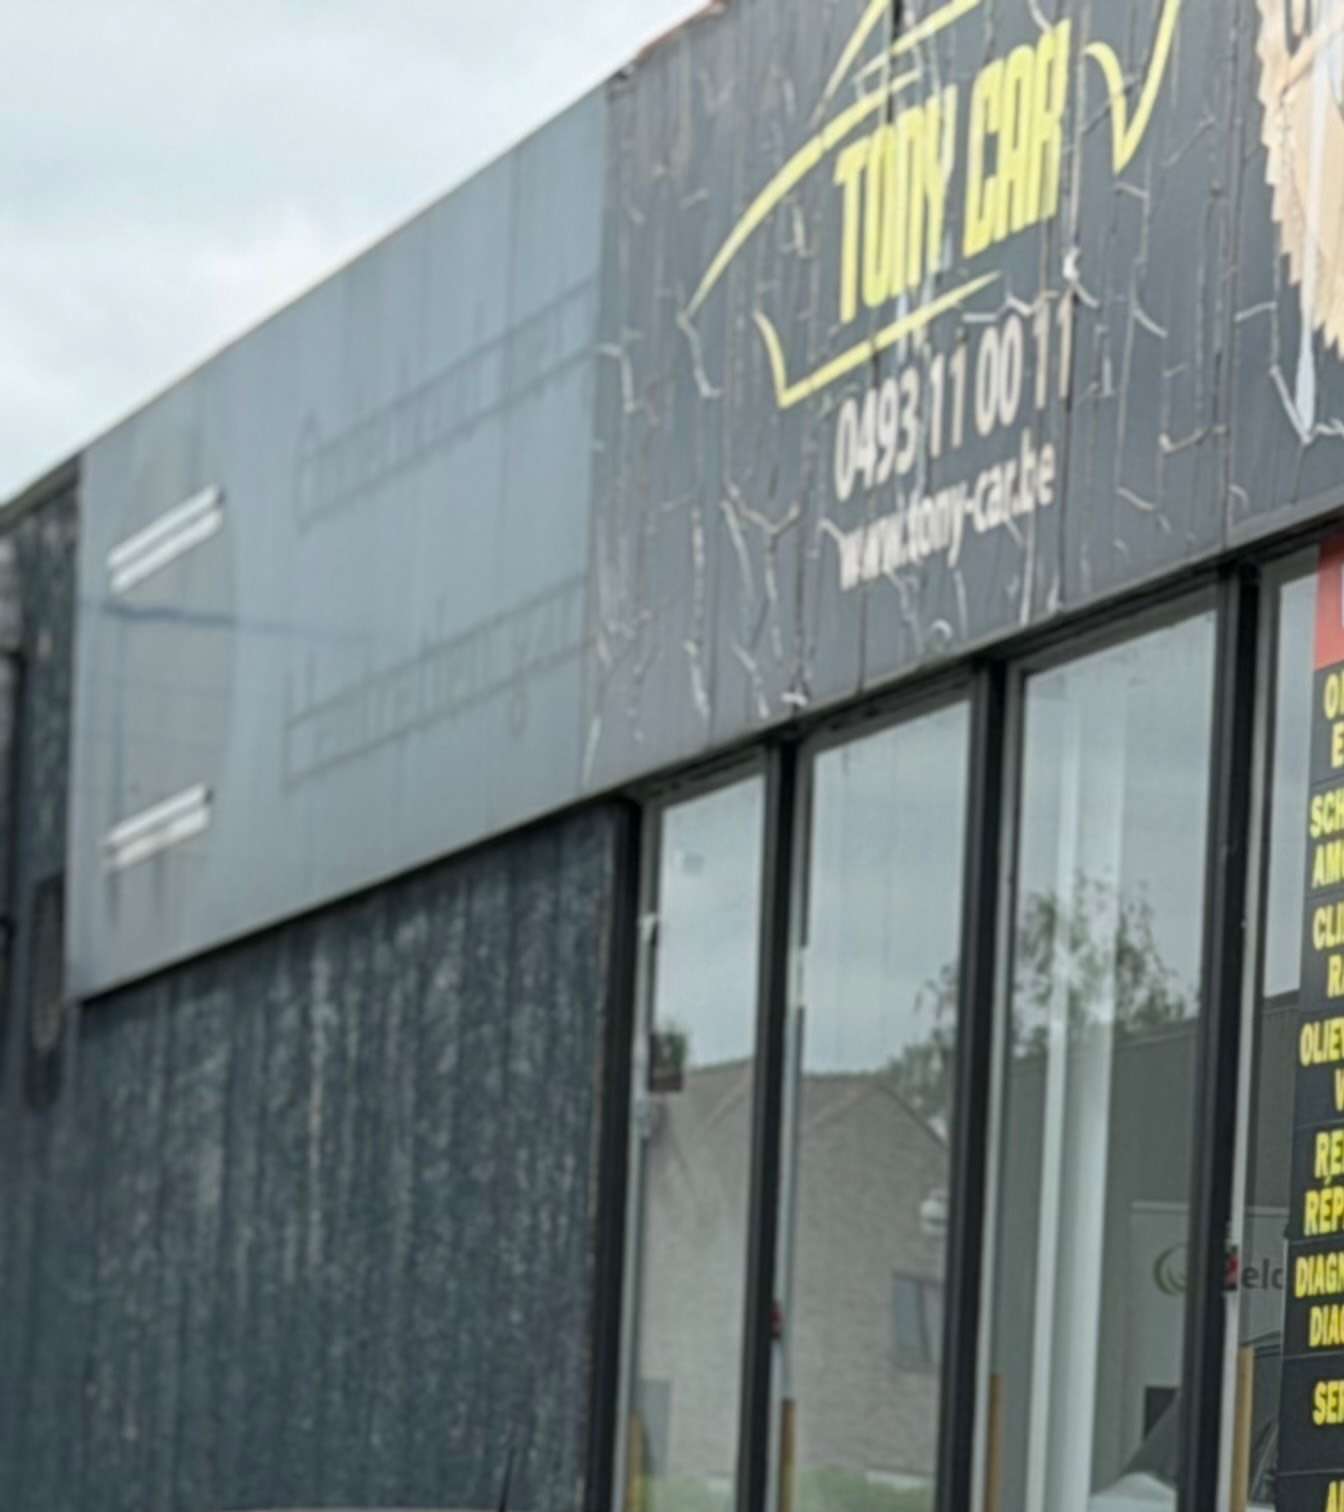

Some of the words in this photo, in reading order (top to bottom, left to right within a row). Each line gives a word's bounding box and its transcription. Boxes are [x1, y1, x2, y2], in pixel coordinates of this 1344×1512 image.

[833, 84, 956, 324] TONY
[963, 18, 1071, 259] CAR
[834, 366, 920, 502] 0493
[929, 344, 967, 459] 11
[974, 314, 1023, 437] 00
[1032, 296, 1074, 411] 11
[838, 427, 1056, 591] www.tony-car.be
